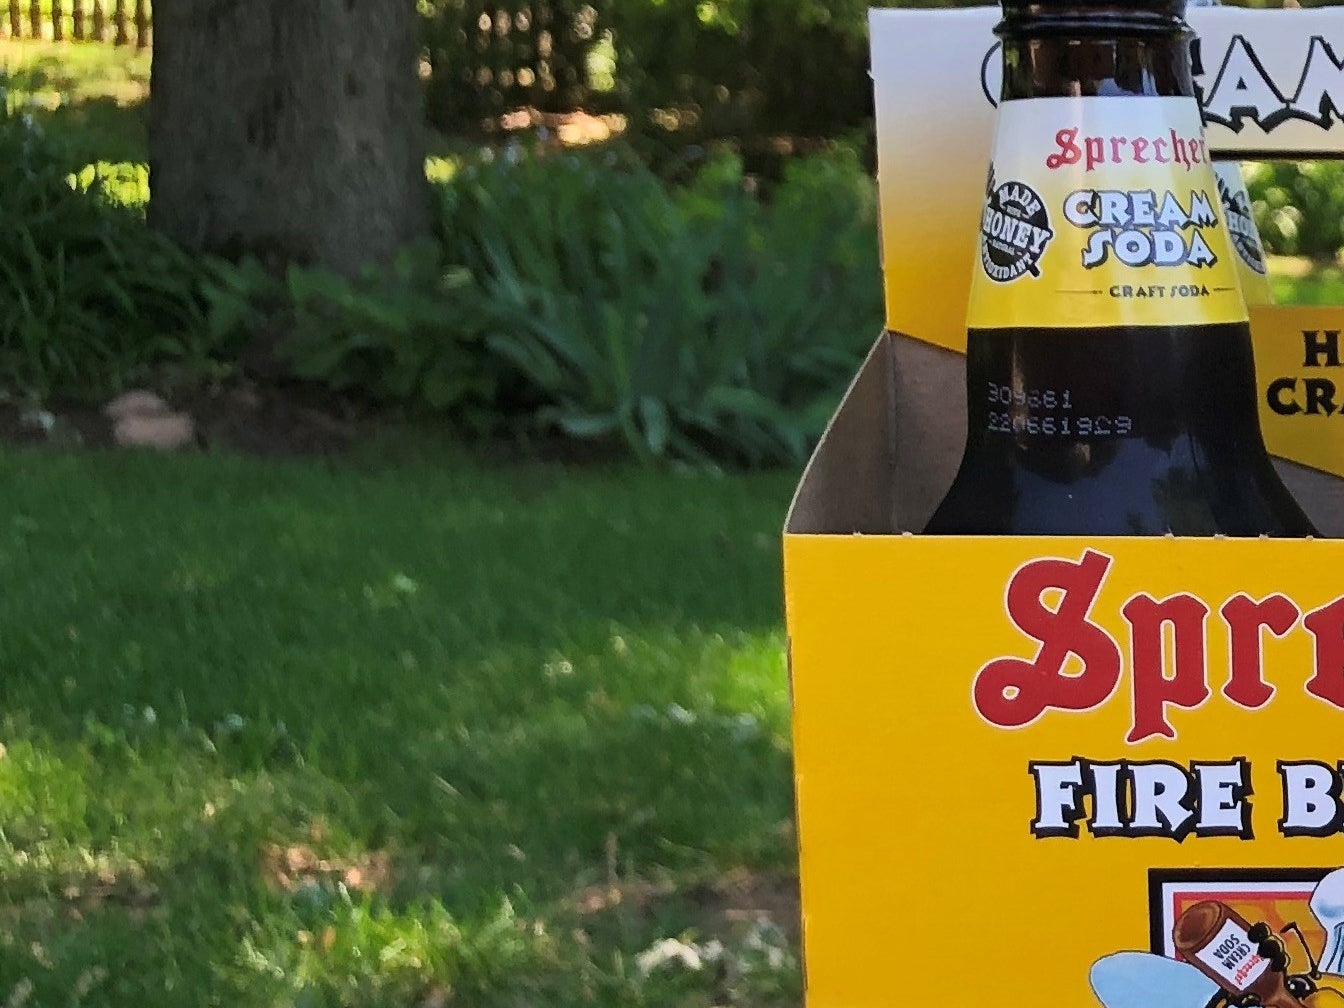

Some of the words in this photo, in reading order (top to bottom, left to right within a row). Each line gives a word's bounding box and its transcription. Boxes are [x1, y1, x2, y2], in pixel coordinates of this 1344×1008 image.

[998, 184, 1042, 217] MADE
[1063, 189, 1219, 230] CREAM
[982, 205, 1051, 254] HONEY
[1081, 228, 1218, 269] SODA
[1109, 285, 1166, 299] CRAFT
[1170, 284, 1210, 298] SODA
[1028, 755, 1256, 843] FIRE
